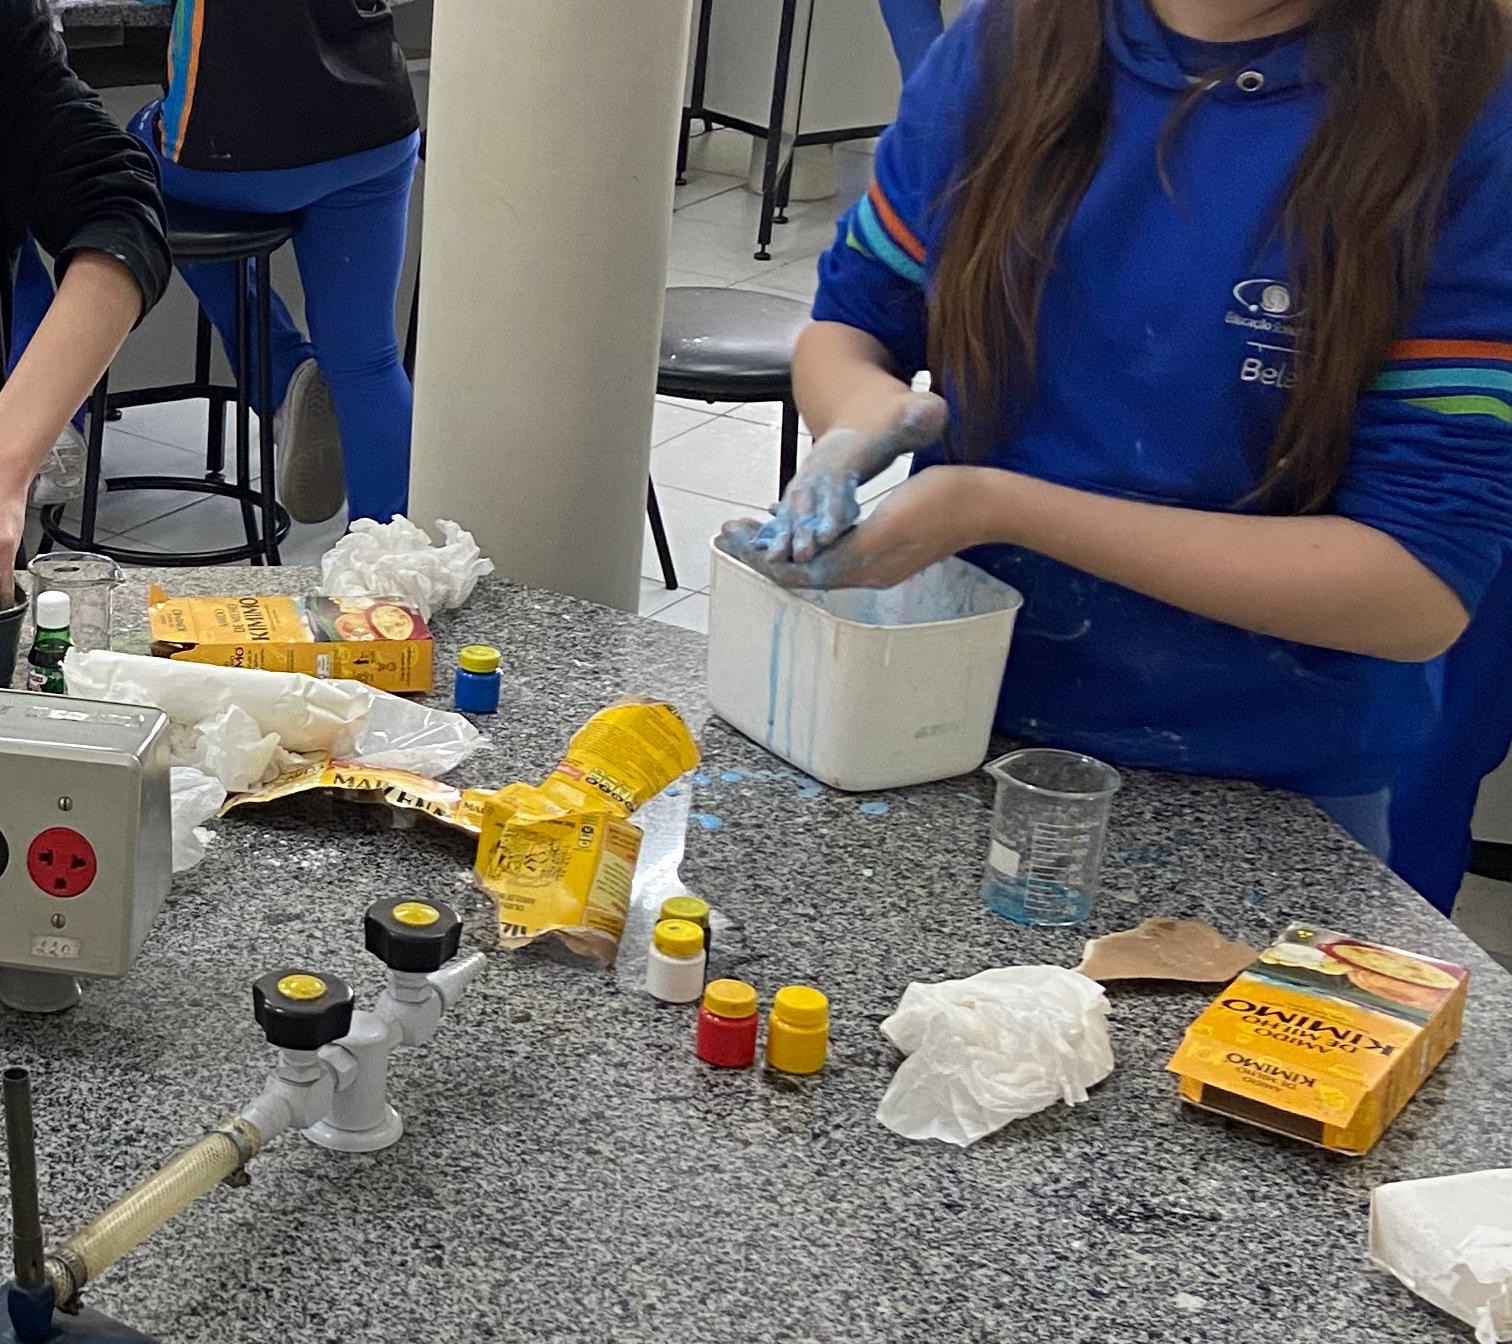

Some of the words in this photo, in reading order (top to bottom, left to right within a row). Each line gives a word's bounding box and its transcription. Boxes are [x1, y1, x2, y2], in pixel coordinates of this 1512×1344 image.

[239, 597, 270, 641] KIMIMO
[1221, 999, 1395, 1057] KIMIMO
[1241, 1015, 1323, 1041] MILHO
[1254, 1027, 1334, 1054] AMIDO
[1226, 1052, 1317, 1088] KIMIMO
